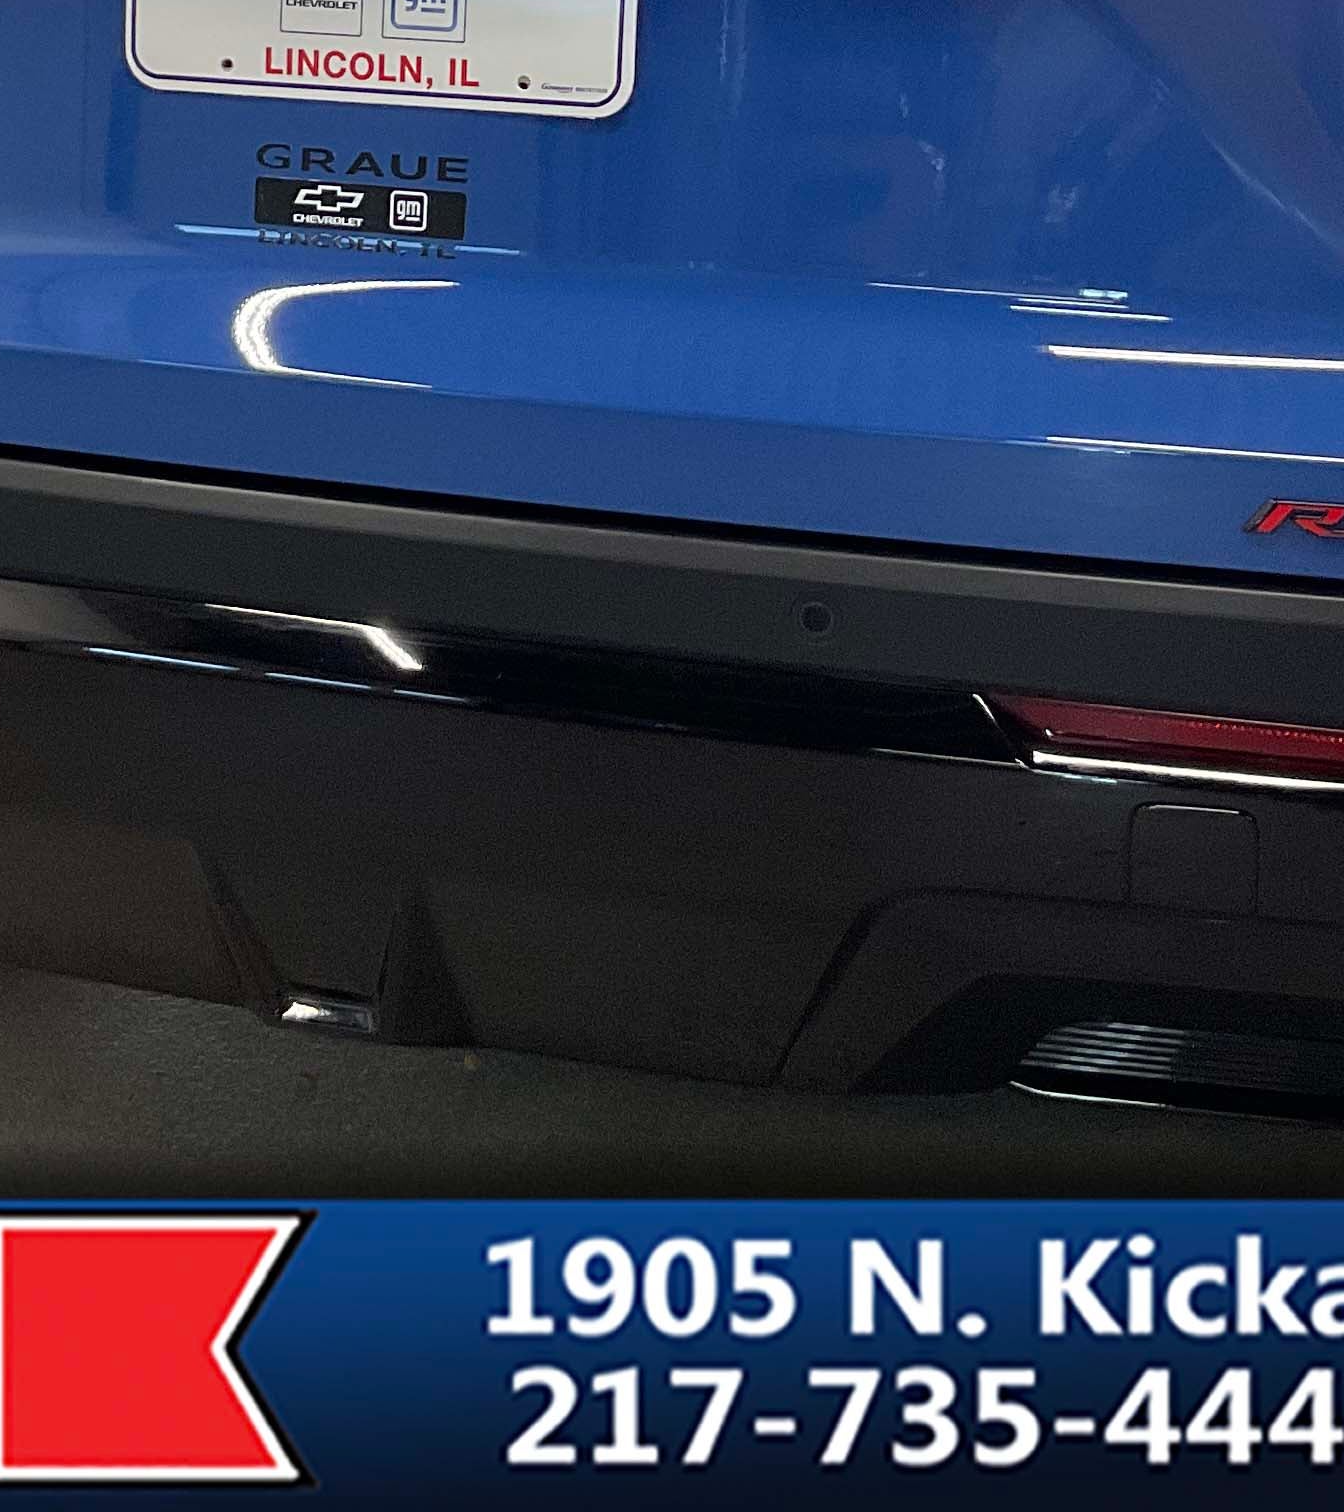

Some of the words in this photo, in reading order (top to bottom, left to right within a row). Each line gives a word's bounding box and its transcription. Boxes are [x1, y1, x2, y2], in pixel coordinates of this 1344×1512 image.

[264, 47, 433, 90] LINCOLN,
[449, 58, 480, 87] IL
[257, 144, 469, 183] GRAUE
[293, 213, 364, 227] CHEVROLET
[396, 199, 421, 221] gm
